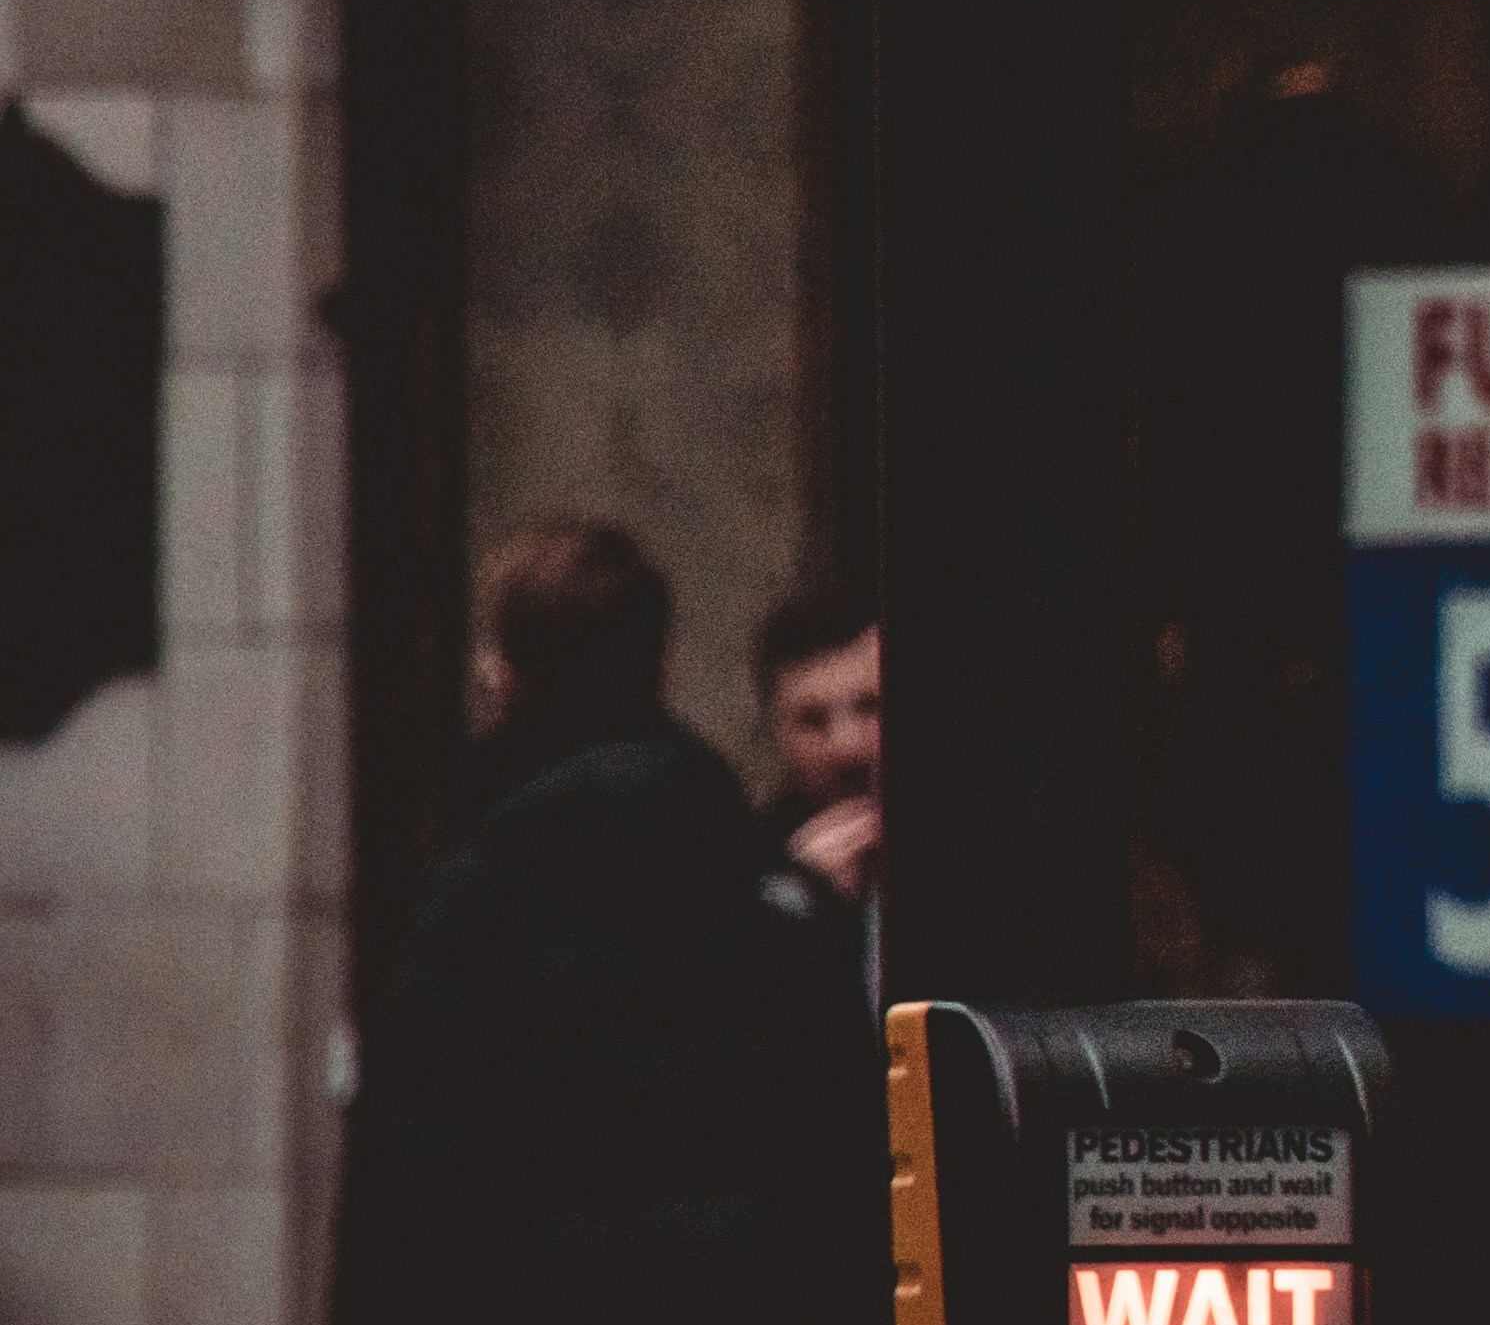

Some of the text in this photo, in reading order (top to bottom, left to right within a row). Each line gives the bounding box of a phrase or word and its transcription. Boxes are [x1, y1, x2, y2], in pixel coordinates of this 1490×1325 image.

[1074, 1128, 1334, 1163] PEDESTRIANS
[1074, 1172, 1333, 1201] push button and wait
[1090, 1206, 1317, 1235] for signal opposite
